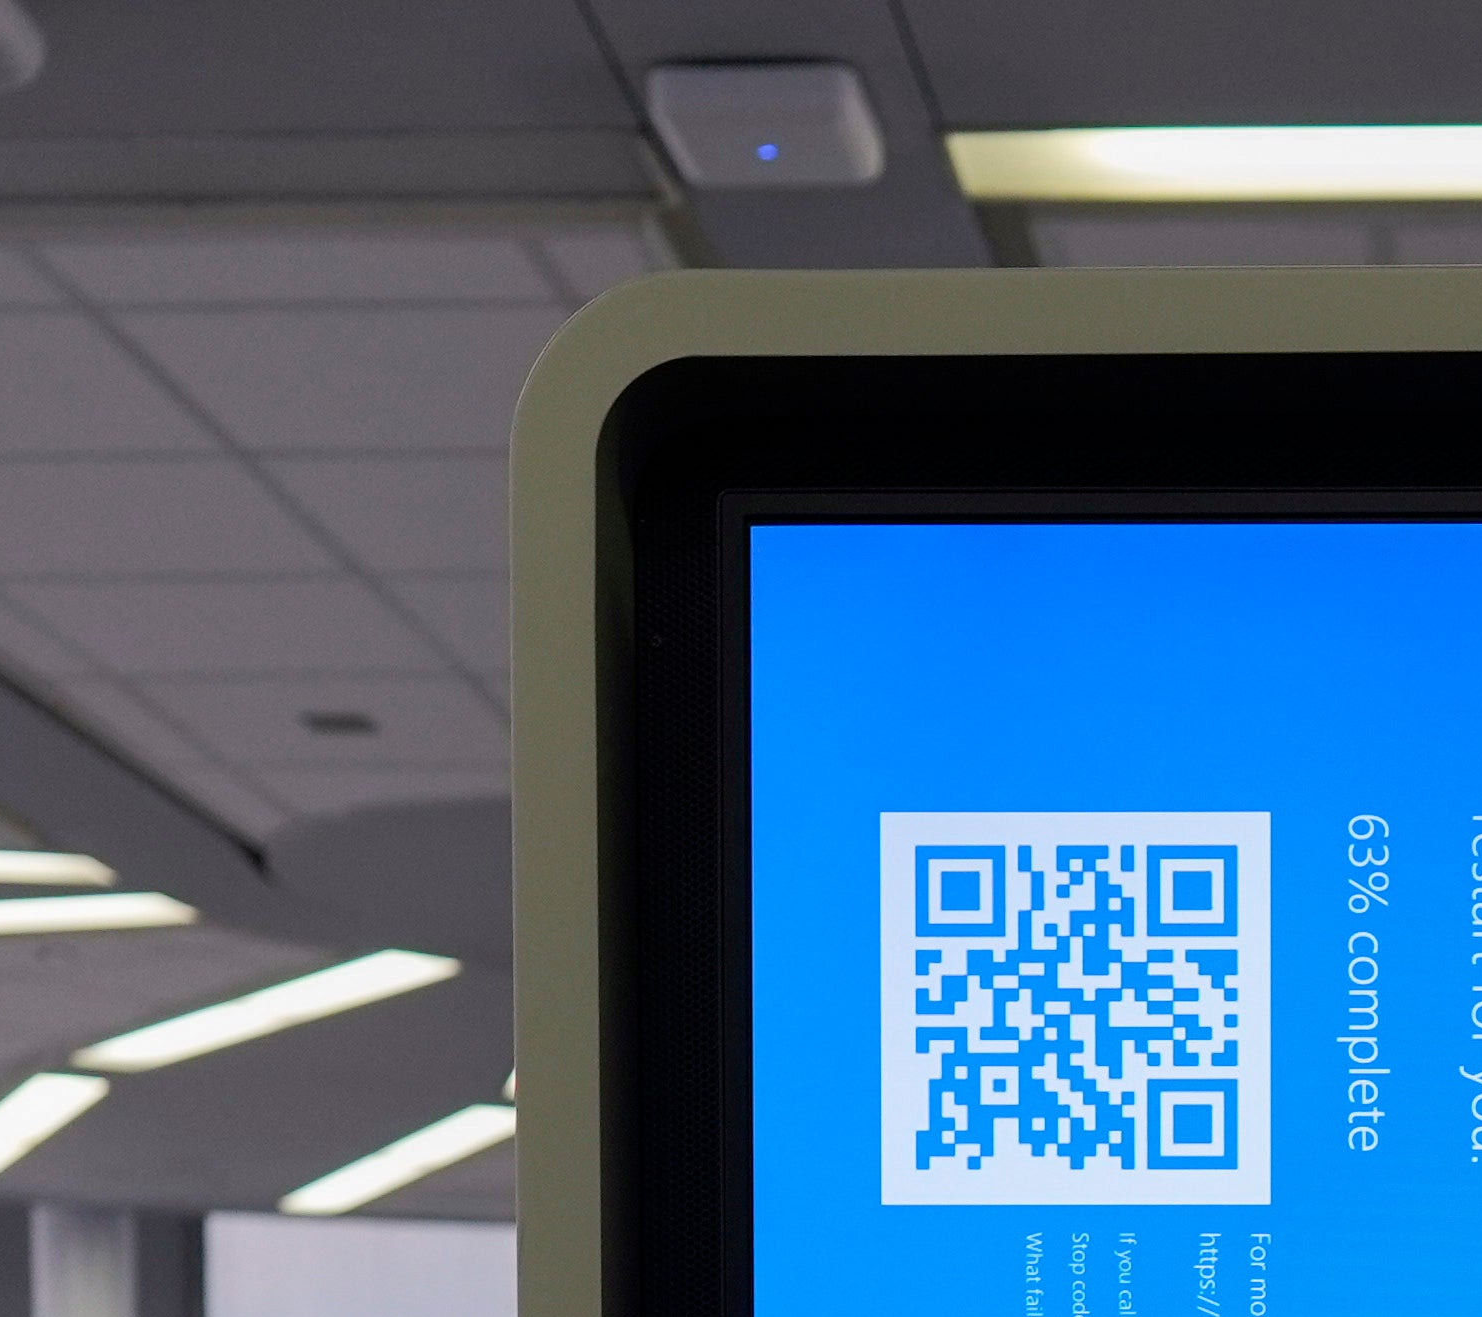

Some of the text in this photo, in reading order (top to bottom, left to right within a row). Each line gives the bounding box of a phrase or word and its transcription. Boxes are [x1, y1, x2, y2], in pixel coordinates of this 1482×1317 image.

[1336, 814, 1391, 1152] 63% complete
[1025, 1232, 1043, 1282] What
[1069, 1232, 1090, 1275] Stop
[1119, 1232, 1137, 1245] If
[1249, 1233, 1272, 1271] For
[1114, 1250, 1132, 1284] you
